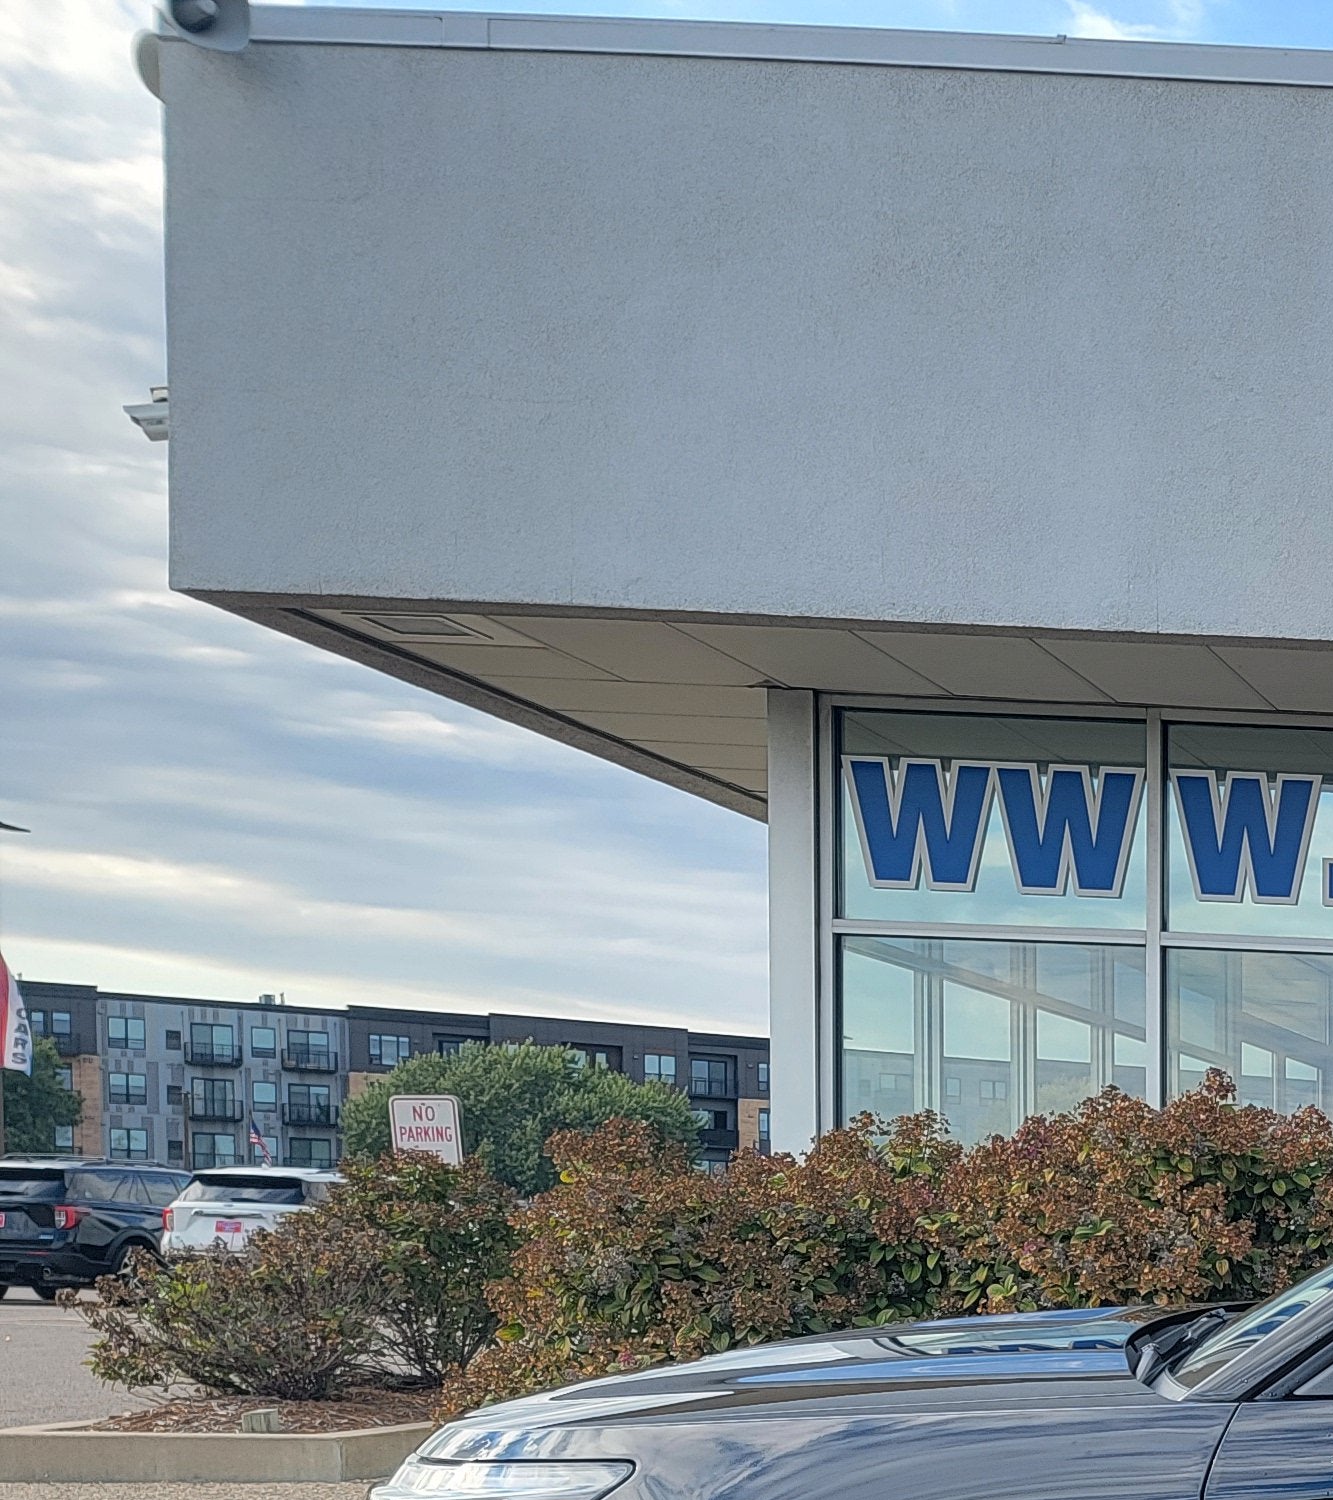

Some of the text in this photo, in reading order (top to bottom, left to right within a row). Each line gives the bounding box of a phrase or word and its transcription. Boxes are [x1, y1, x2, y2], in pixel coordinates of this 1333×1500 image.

[11, 1007, 29, 1065] CARS
[412, 1105, 435, 1121] NO
[399, 1126, 453, 1142] PARKING
